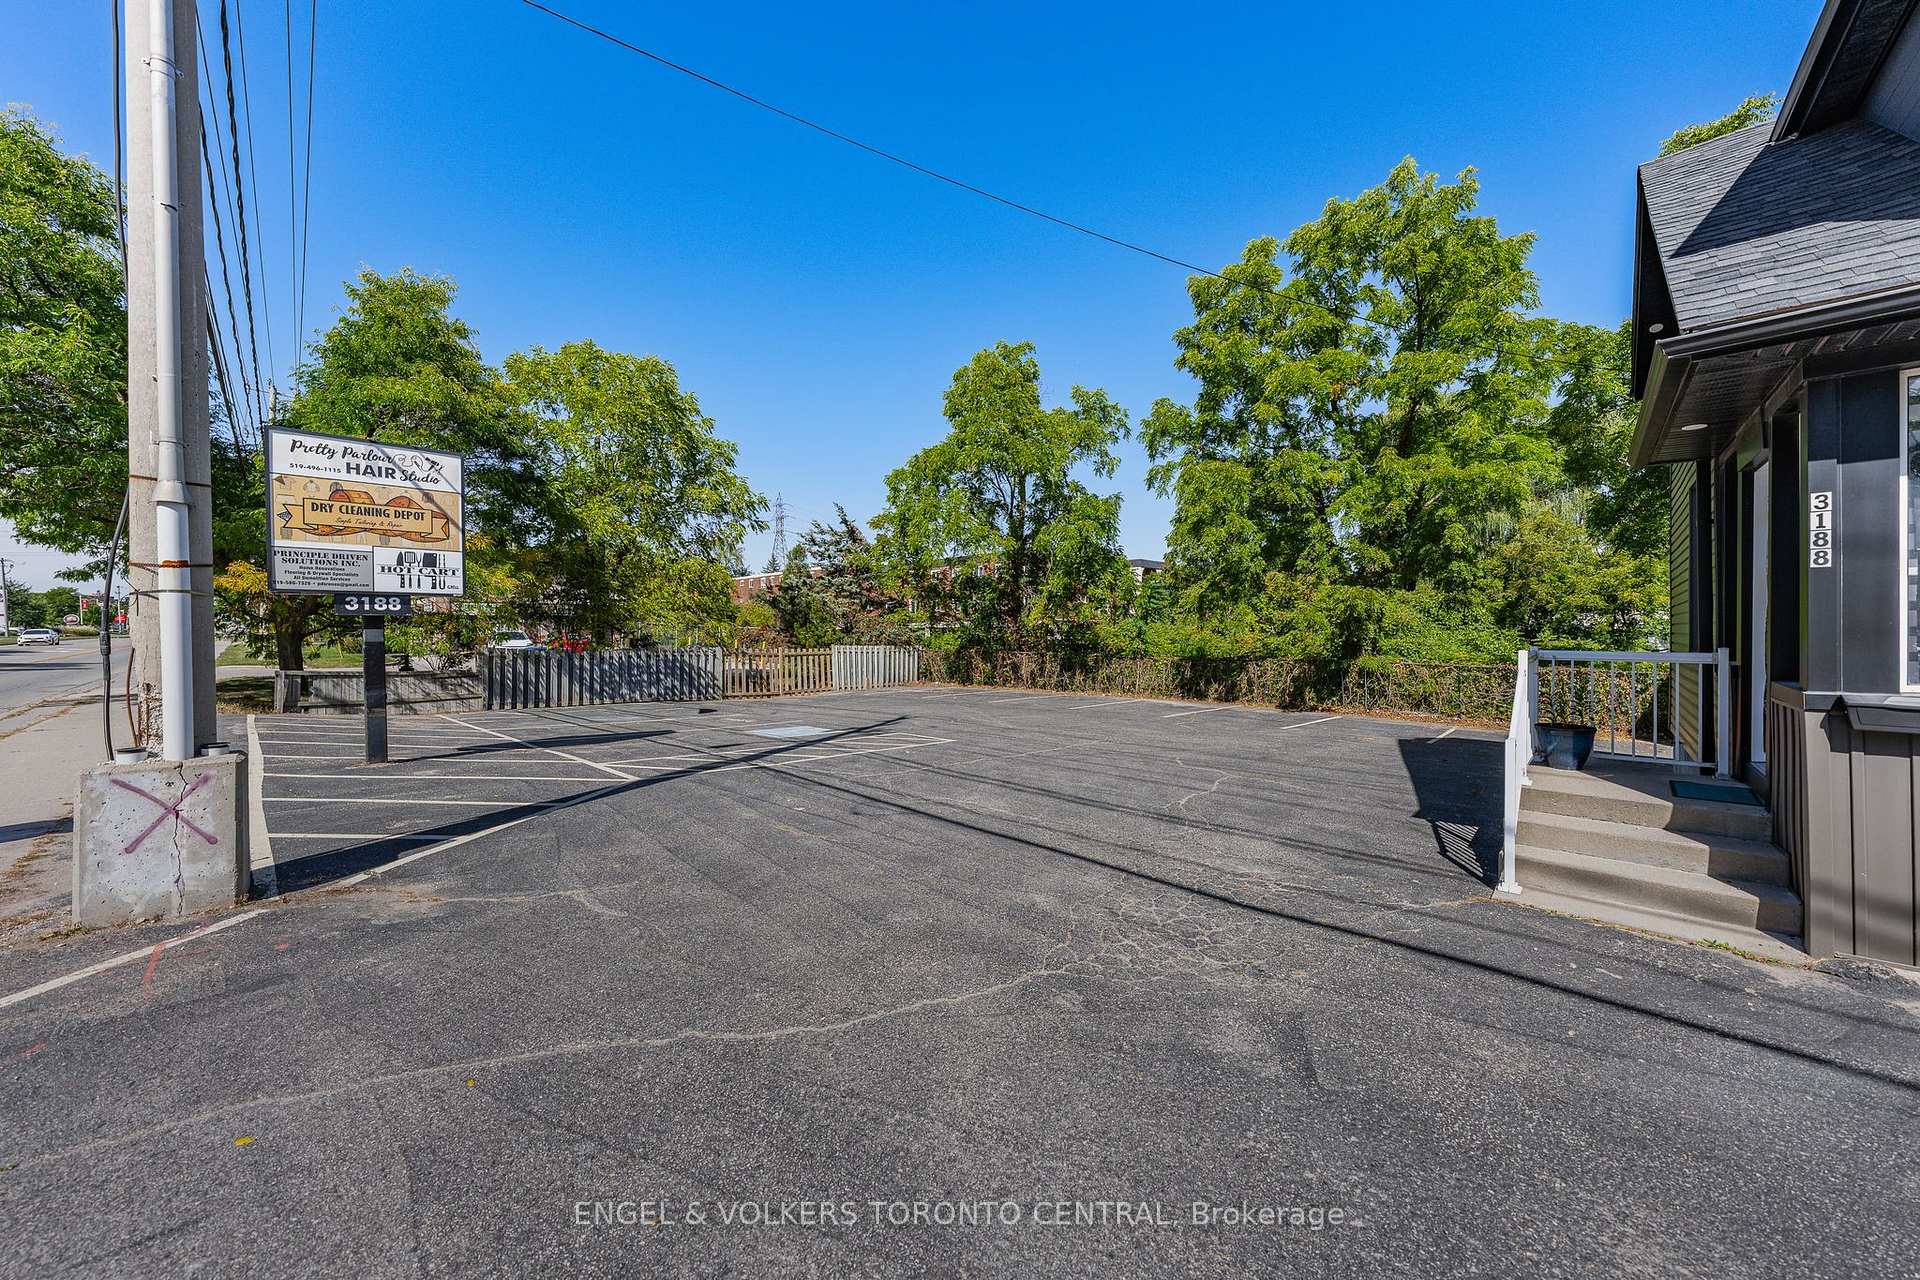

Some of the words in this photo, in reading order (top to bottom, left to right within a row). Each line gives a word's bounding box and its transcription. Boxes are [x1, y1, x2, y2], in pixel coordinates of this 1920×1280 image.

[290, 438, 338, 460] Pretty
[342, 446, 394, 463] Parlour
[289, 462, 341, 473] 519-496-1115
[345, 462, 397, 480] HAIR
[399, 469, 441, 485] Studio
[311, 502, 334, 513] DRY
[339, 504, 390, 518] CLEANING
[394, 510, 425, 521] DEPOT
[1812, 494, 1830, 566] 3188
[273, 550, 330, 559] PRINCIPLE
[332, 553, 368, 561] DRIVEN
[281, 557, 338, 566] SOLUTIONS
[380, 565, 415, 574] HOT
[418, 567, 460, 576] CART
[344, 596, 402, 611] 3188
